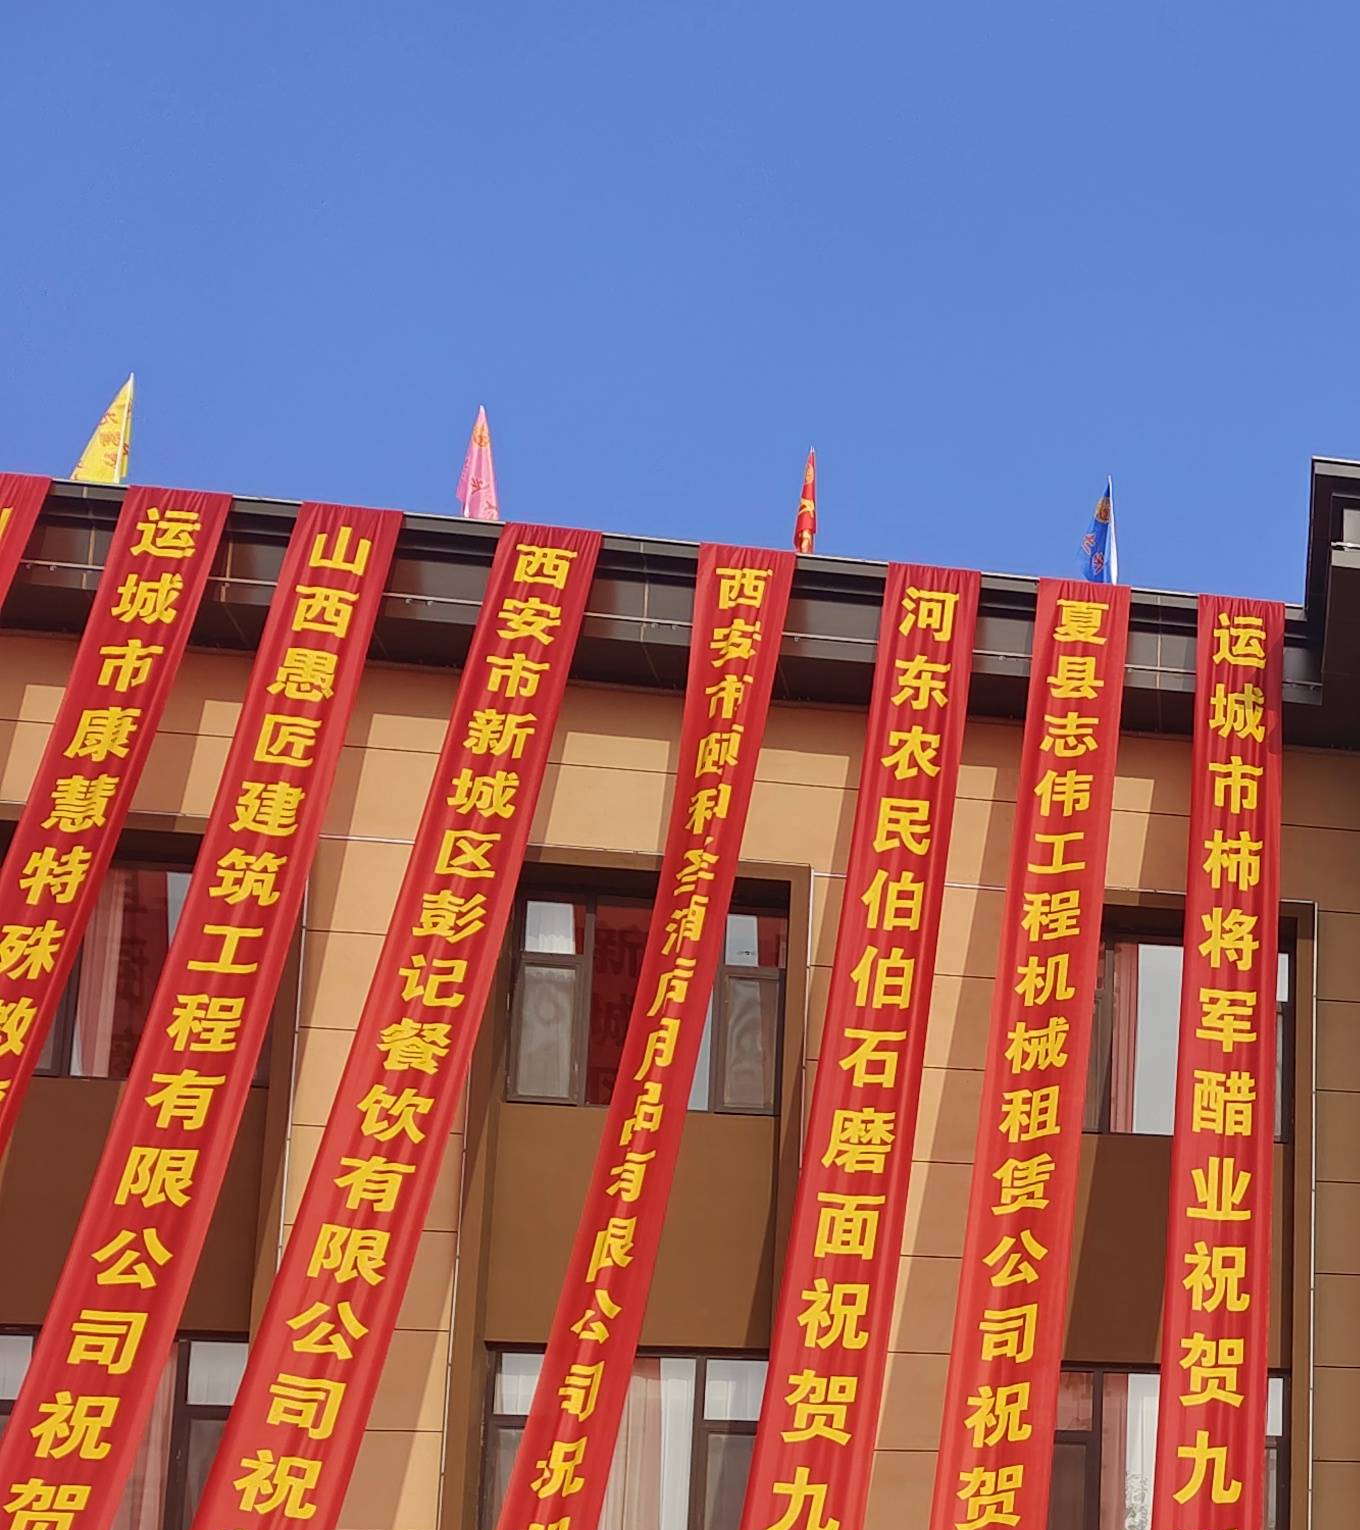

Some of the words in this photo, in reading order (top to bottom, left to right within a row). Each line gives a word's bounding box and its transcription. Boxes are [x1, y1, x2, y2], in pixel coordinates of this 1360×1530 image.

[0, 507, 201, 1120] 运城市康慧特殊
